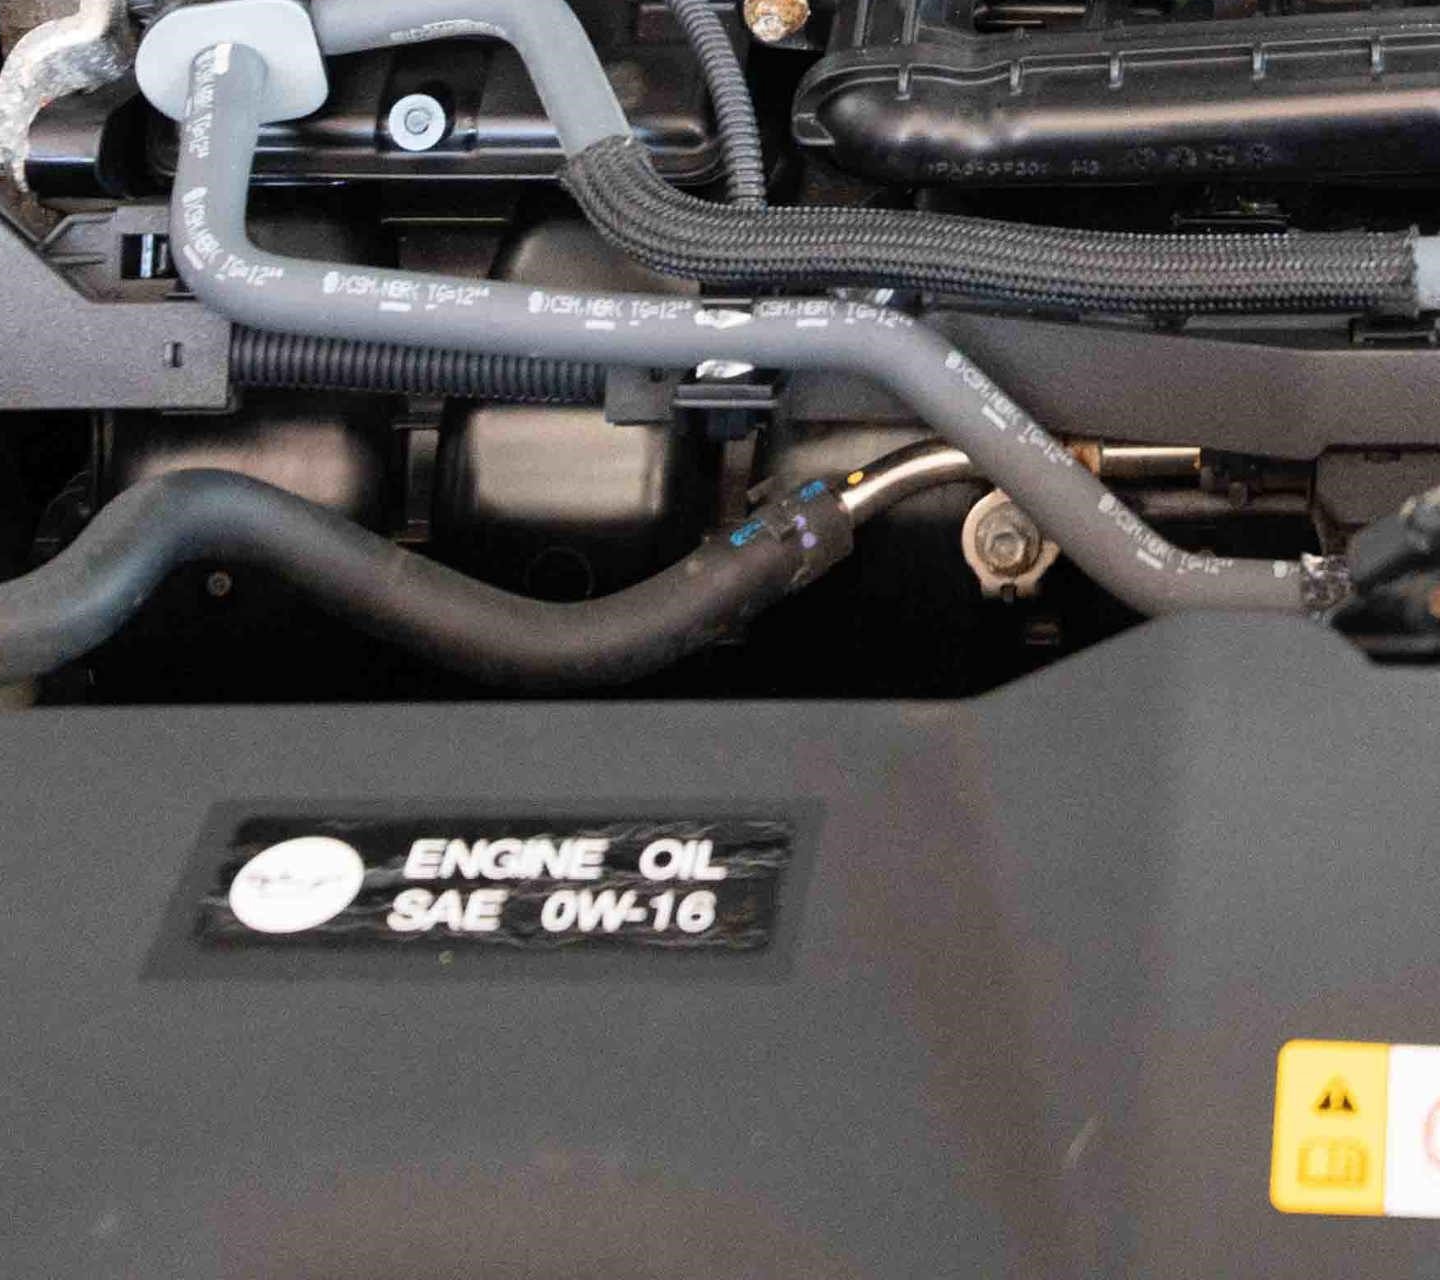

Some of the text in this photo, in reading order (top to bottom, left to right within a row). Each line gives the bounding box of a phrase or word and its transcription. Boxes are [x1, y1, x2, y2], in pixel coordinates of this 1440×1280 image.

[402, 837, 730, 881] ENGINE OIL
[386, 888, 718, 934] SAE 0W-16
